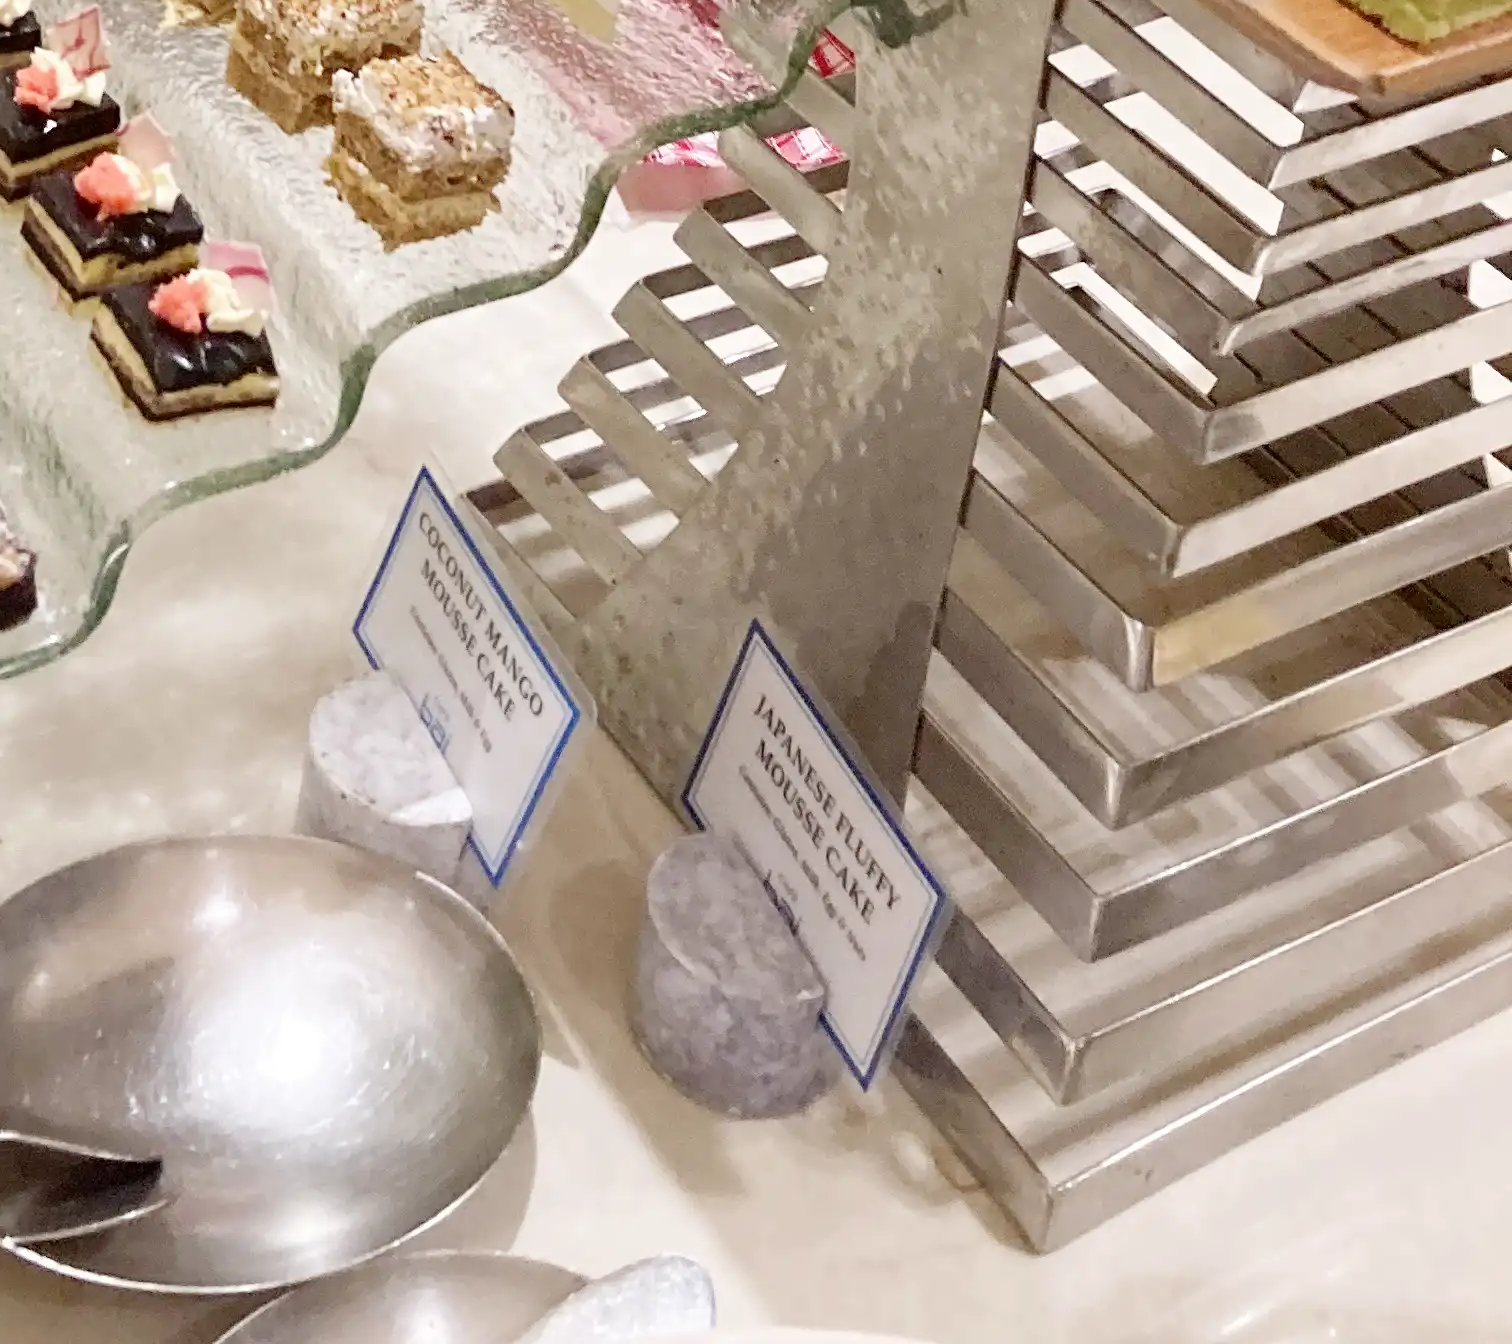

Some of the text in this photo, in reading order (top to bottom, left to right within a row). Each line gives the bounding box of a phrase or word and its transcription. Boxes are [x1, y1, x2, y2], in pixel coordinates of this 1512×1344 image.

[419, 512, 543, 716] COCONUT MANGO
[420, 558, 516, 722] MOUSSE CAKE
[754, 693, 901, 910] JAPANESE FLUFFY
[755, 739, 875, 925] MOUSSE CAKE
